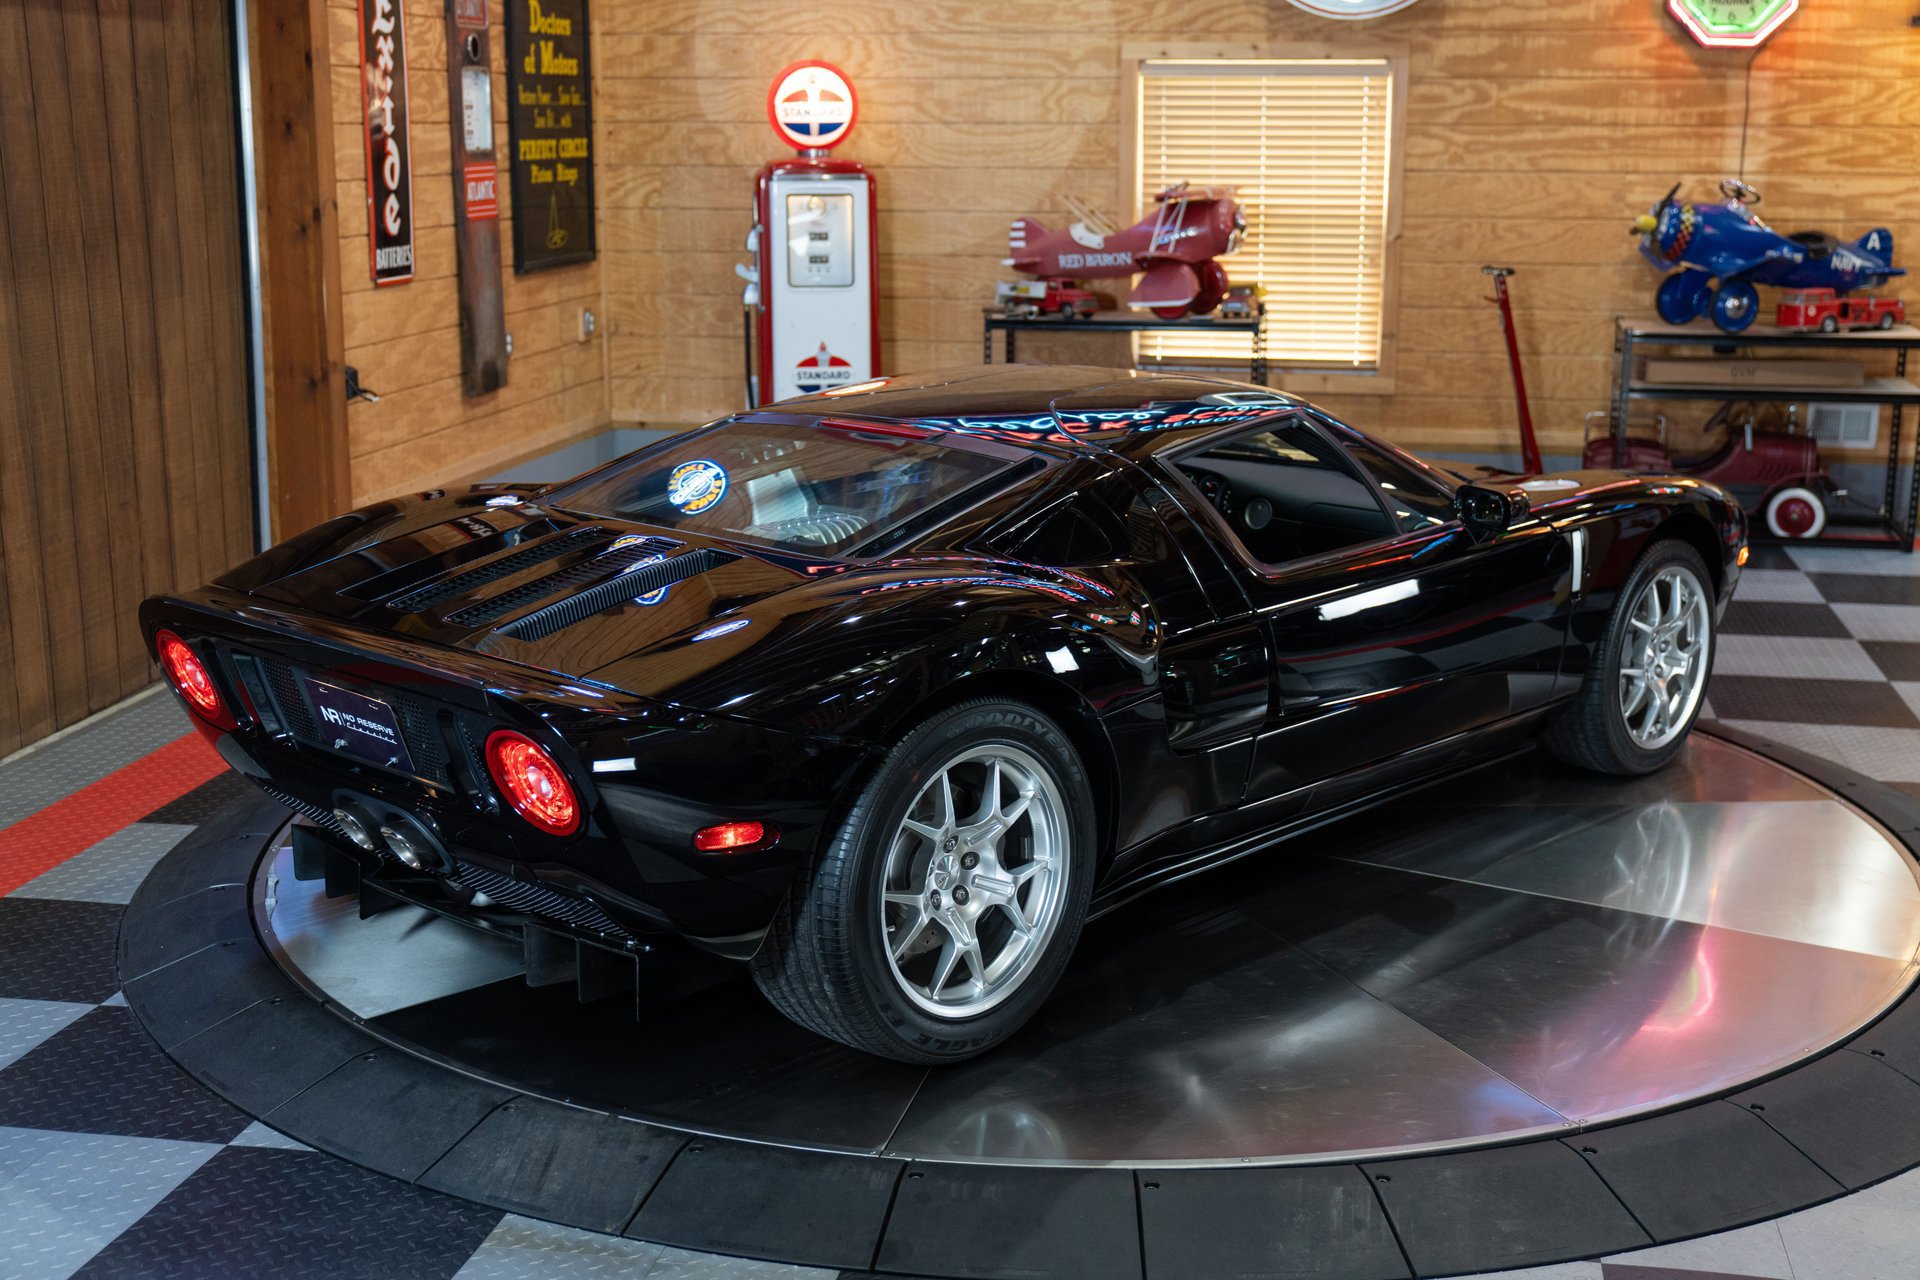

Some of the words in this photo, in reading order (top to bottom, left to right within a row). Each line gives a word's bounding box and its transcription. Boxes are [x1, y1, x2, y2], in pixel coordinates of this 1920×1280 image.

[528, 0, 571, 36] Doctors
[523, 43, 536, 74] of
[540, 40, 578, 76] Motors
[518, 138, 557, 160] PERFECT
[559, 137, 588, 158] CIRCLE
[556, 162, 579, 187] Rings
[467, 180, 496, 202] ATLANTIC
[1866, 231, 1880, 251] A
[376, 244, 412, 271] BATTERIES
[1058, 254, 1084, 269] RED
[1085, 252, 1133, 267] BARON
[1830, 253, 1861, 273] NAVY
[796, 370, 850, 381] STANDARD
[342, 712, 355, 723] NO
[356, 717, 395, 736] RESERVE
